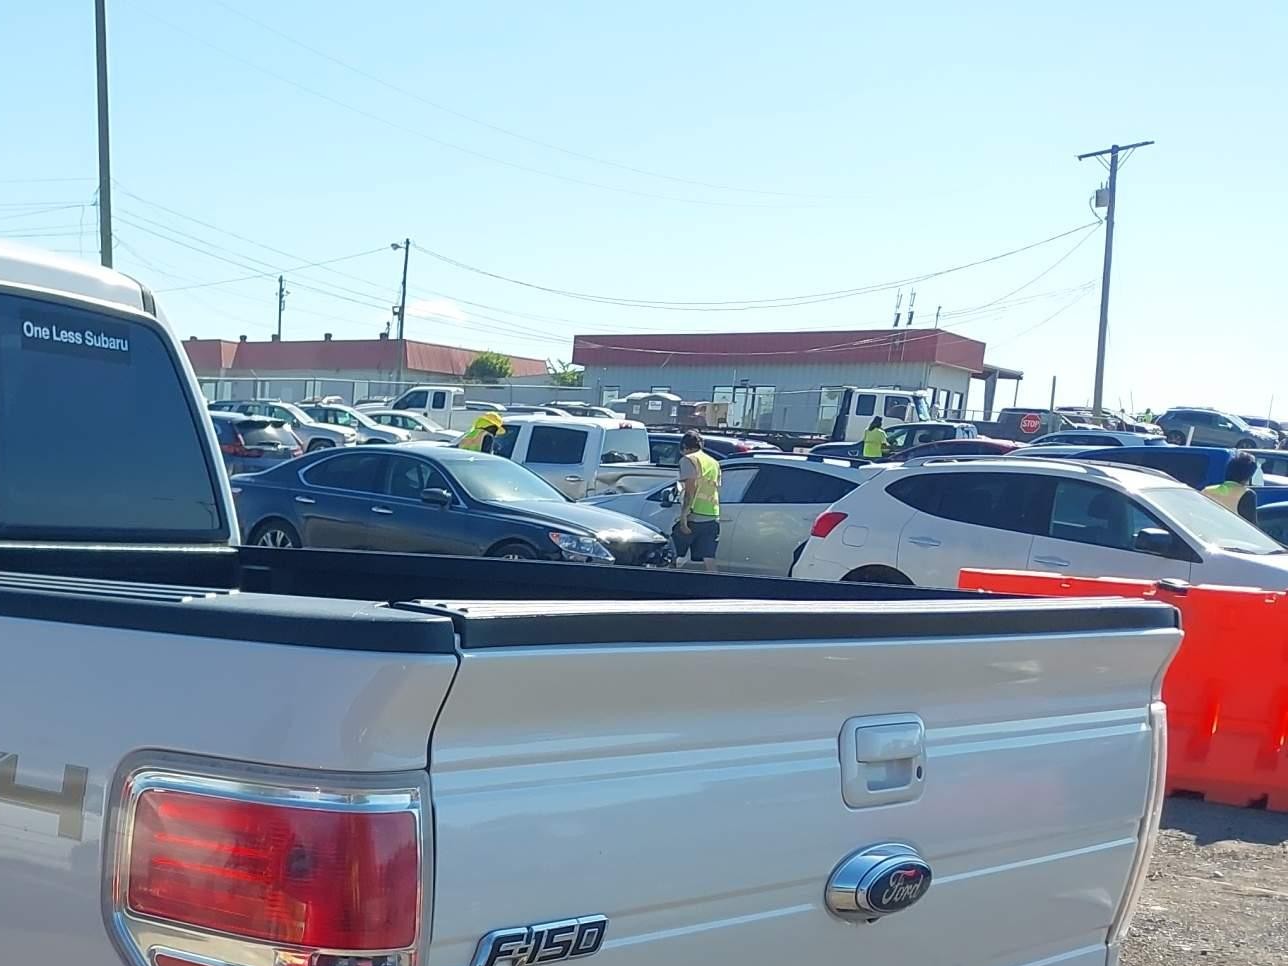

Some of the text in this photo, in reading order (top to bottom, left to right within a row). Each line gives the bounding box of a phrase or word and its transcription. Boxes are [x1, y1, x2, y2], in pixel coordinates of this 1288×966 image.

[22, 320, 129, 352] One Less Subaru
[1022, 419, 1040, 428] STOP
[881, 868, 924, 905] Ford
